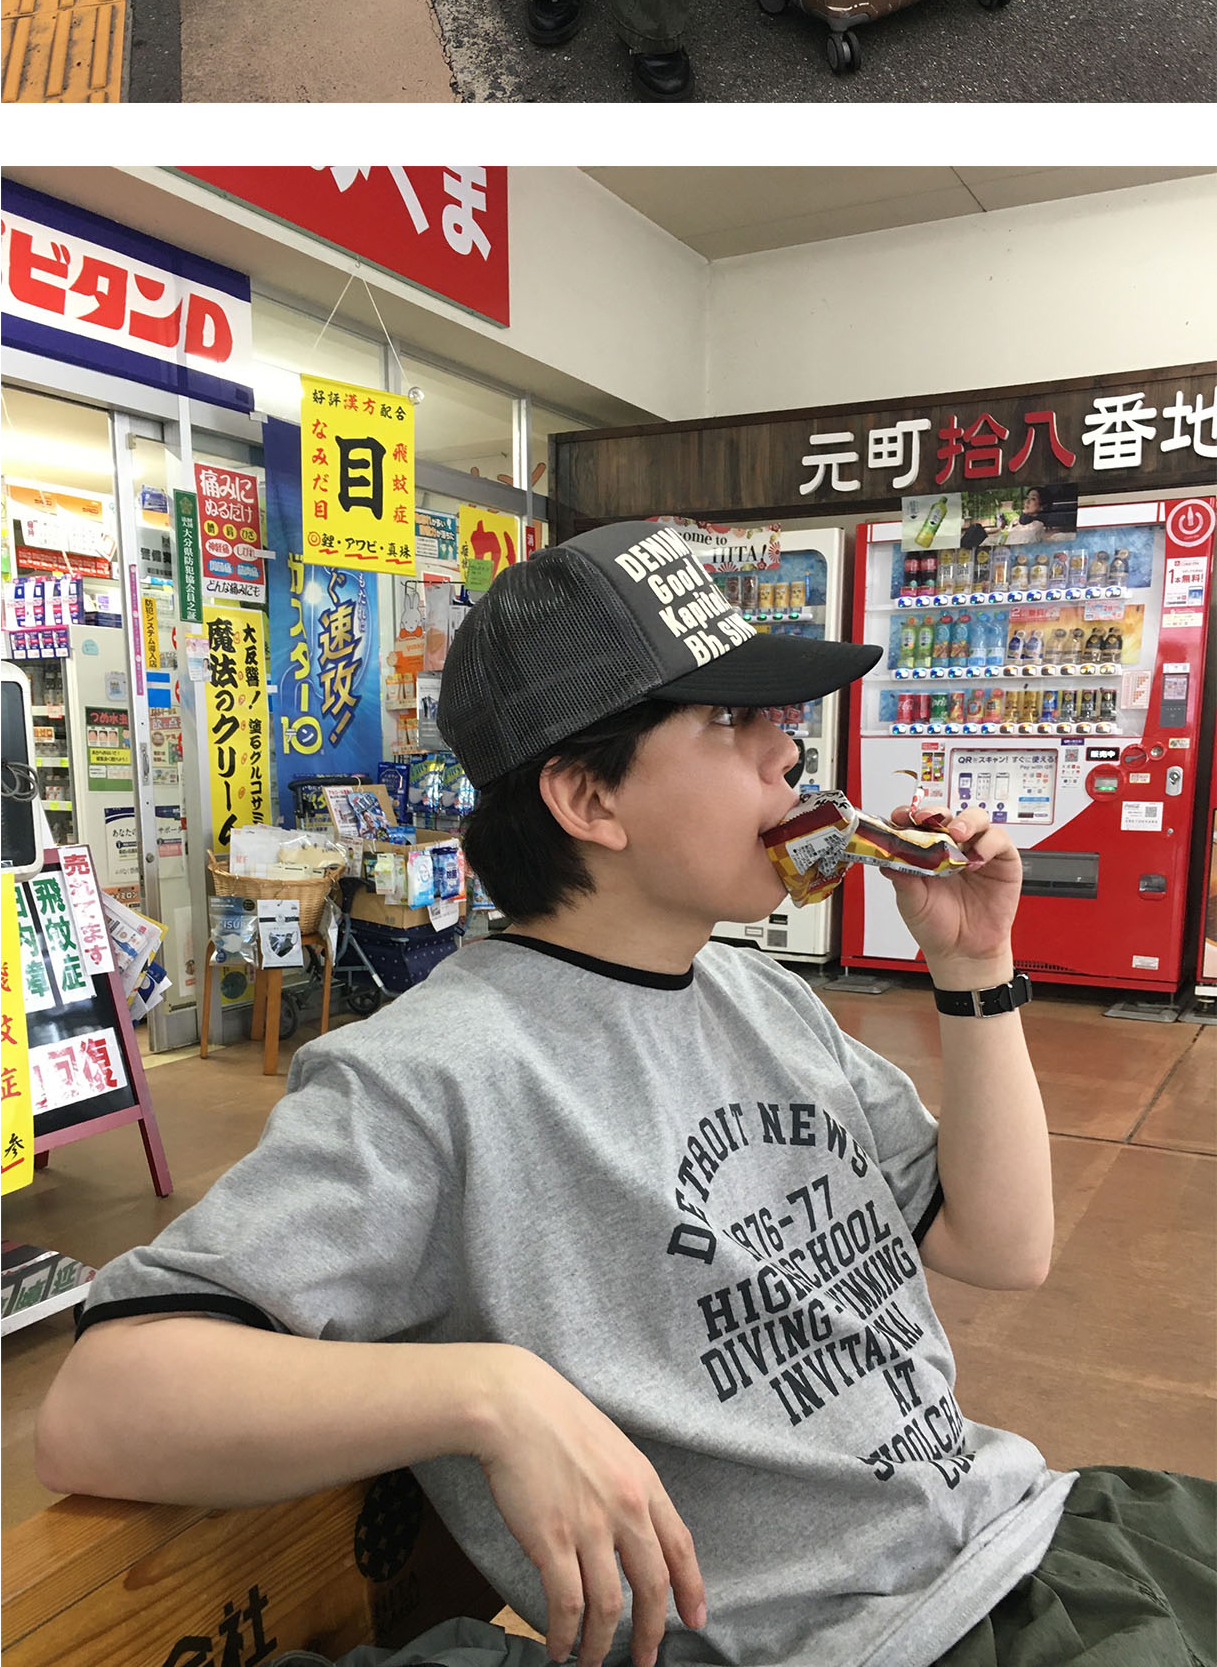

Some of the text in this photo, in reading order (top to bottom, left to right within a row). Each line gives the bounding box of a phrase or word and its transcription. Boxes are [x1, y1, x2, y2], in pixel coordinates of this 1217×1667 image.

[1, 220, 233, 363] ビタンD
[312, 389, 407, 421] 好評漢方配合
[799, 390, 1217, 496] 元町拾八番地
[200, 469, 254, 504] 痛みに
[312, 418, 329, 520] なみだ目
[335, 435, 387, 521] 目
[392, 443, 409, 525] 飛蚊症
[204, 501, 252, 524] ぬるだけ
[716, 537, 728, 545] to
[206, 579, 260, 597] どんな痛みにも
[648, 558, 705, 605] Good
[32, 877, 87, 992] 飛蚊症
[667, 1102, 868, 1265] DETROIT NEWS
[700, 1296, 833, 1403] DIVING
[882, 1357, 922, 1417] AT
